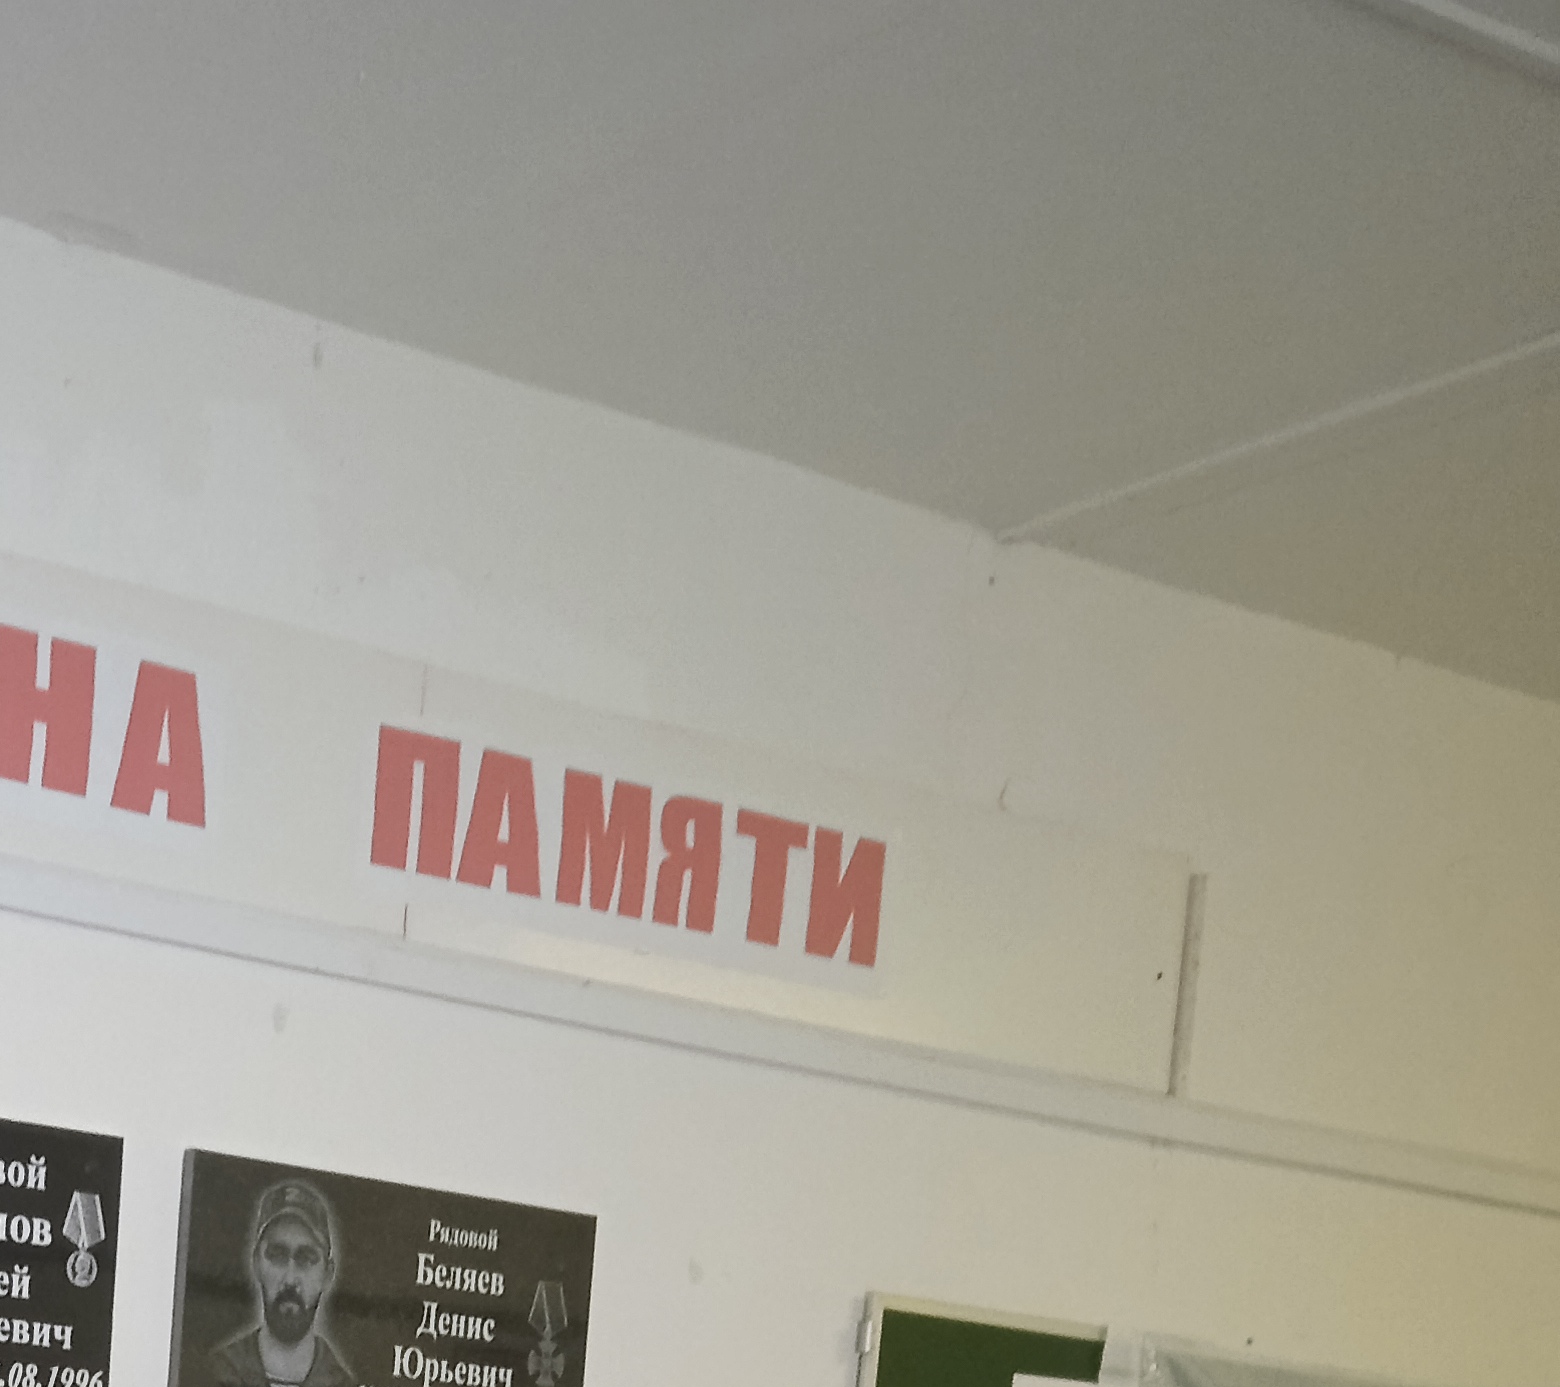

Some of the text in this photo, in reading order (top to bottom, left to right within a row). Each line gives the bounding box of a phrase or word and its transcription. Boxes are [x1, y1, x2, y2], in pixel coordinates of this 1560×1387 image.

[369, 723, 887, 968] ПАМЯТИ
[428, 1218, 499, 1253] Рядовой
[415, 1253, 506, 1297] Беляев
[415, 1301, 497, 1343] Денис
